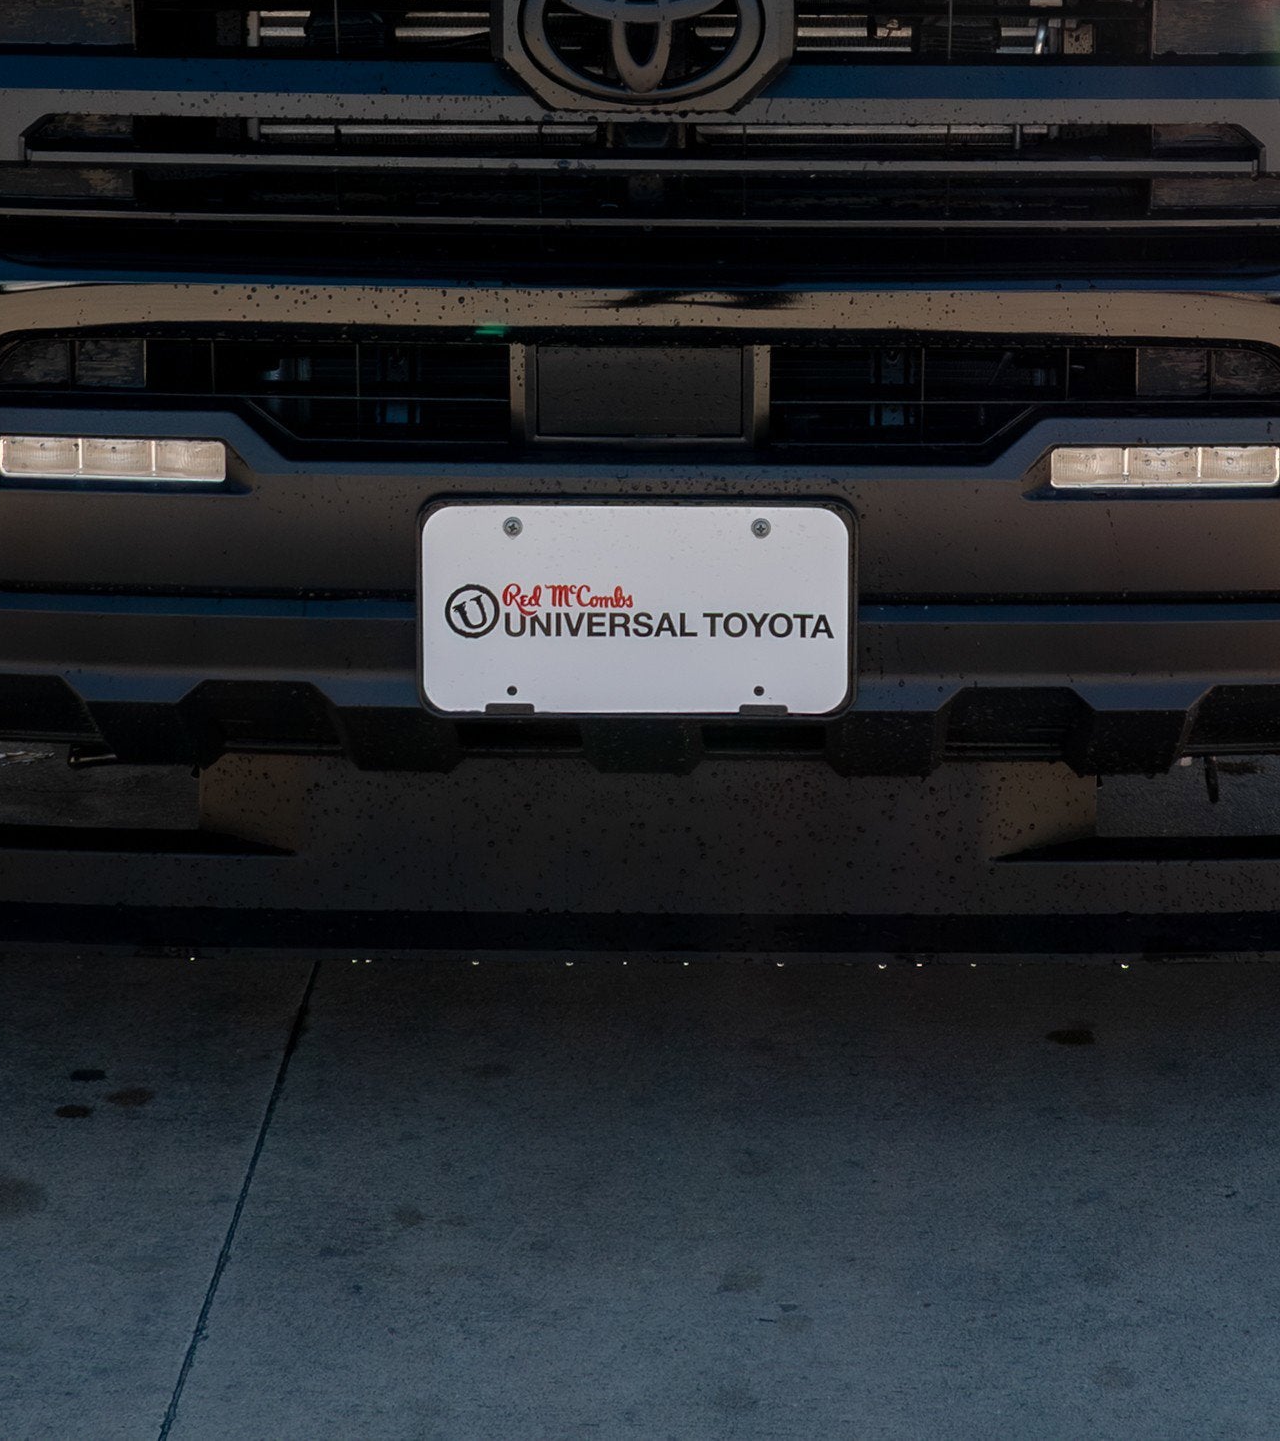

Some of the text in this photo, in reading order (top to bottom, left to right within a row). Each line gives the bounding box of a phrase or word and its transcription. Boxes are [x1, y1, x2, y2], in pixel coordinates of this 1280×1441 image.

[502, 583, 542, 617] Red
[545, 583, 634, 608] McCombs
[504, 611, 835, 639] UNIVERSAL TOYOTA
